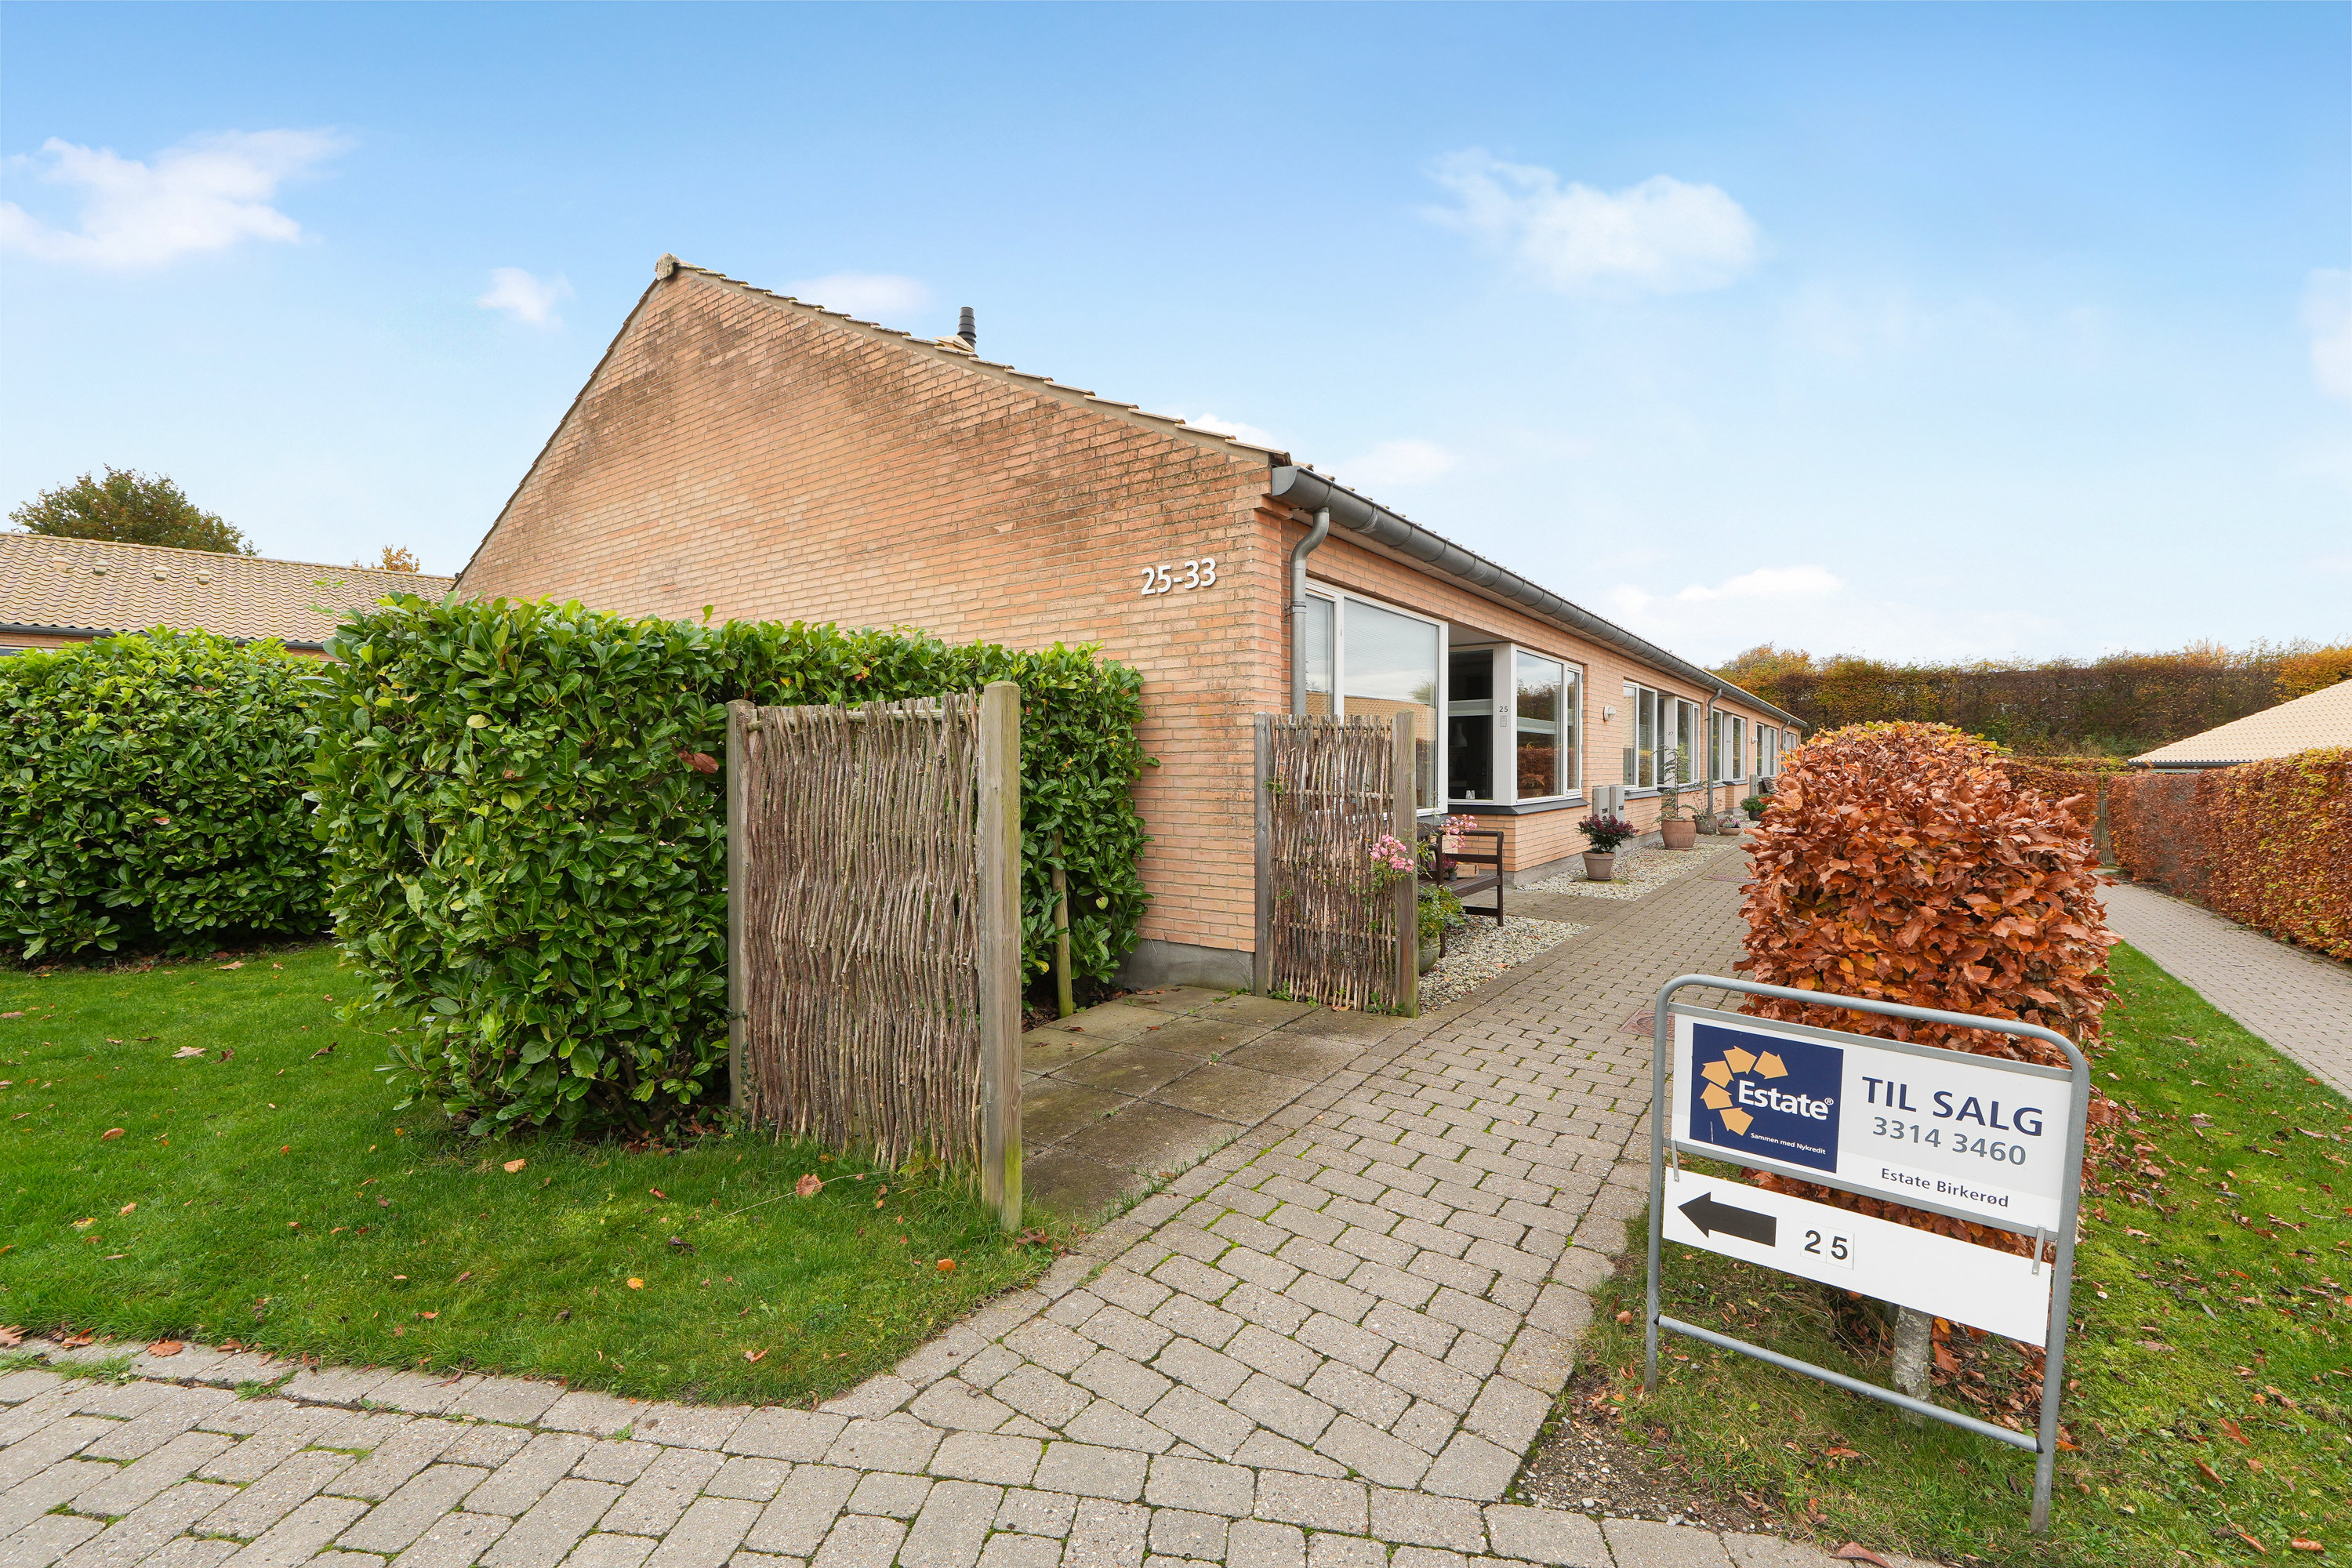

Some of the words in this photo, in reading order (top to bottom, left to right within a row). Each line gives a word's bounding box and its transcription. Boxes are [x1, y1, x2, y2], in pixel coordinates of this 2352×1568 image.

[1141, 557, 1217, 595] 25-33
[1862, 1076, 1917, 1112] TIL
[1932, 1091, 2043, 1137] SALG
[1750, 1132, 1779, 1144] Sammen
[1780, 1139, 1795, 1148] med
[1796, 1142, 1826, 1155] Nykredit
[1872, 1116, 1941, 1148] 3314
[1952, 1133, 2026, 1166] 3460
[1882, 1167, 1931, 1189] Estate
[1936, 1180, 2009, 1208] Birkerød
[1804, 1229, 1848, 1261] 25
